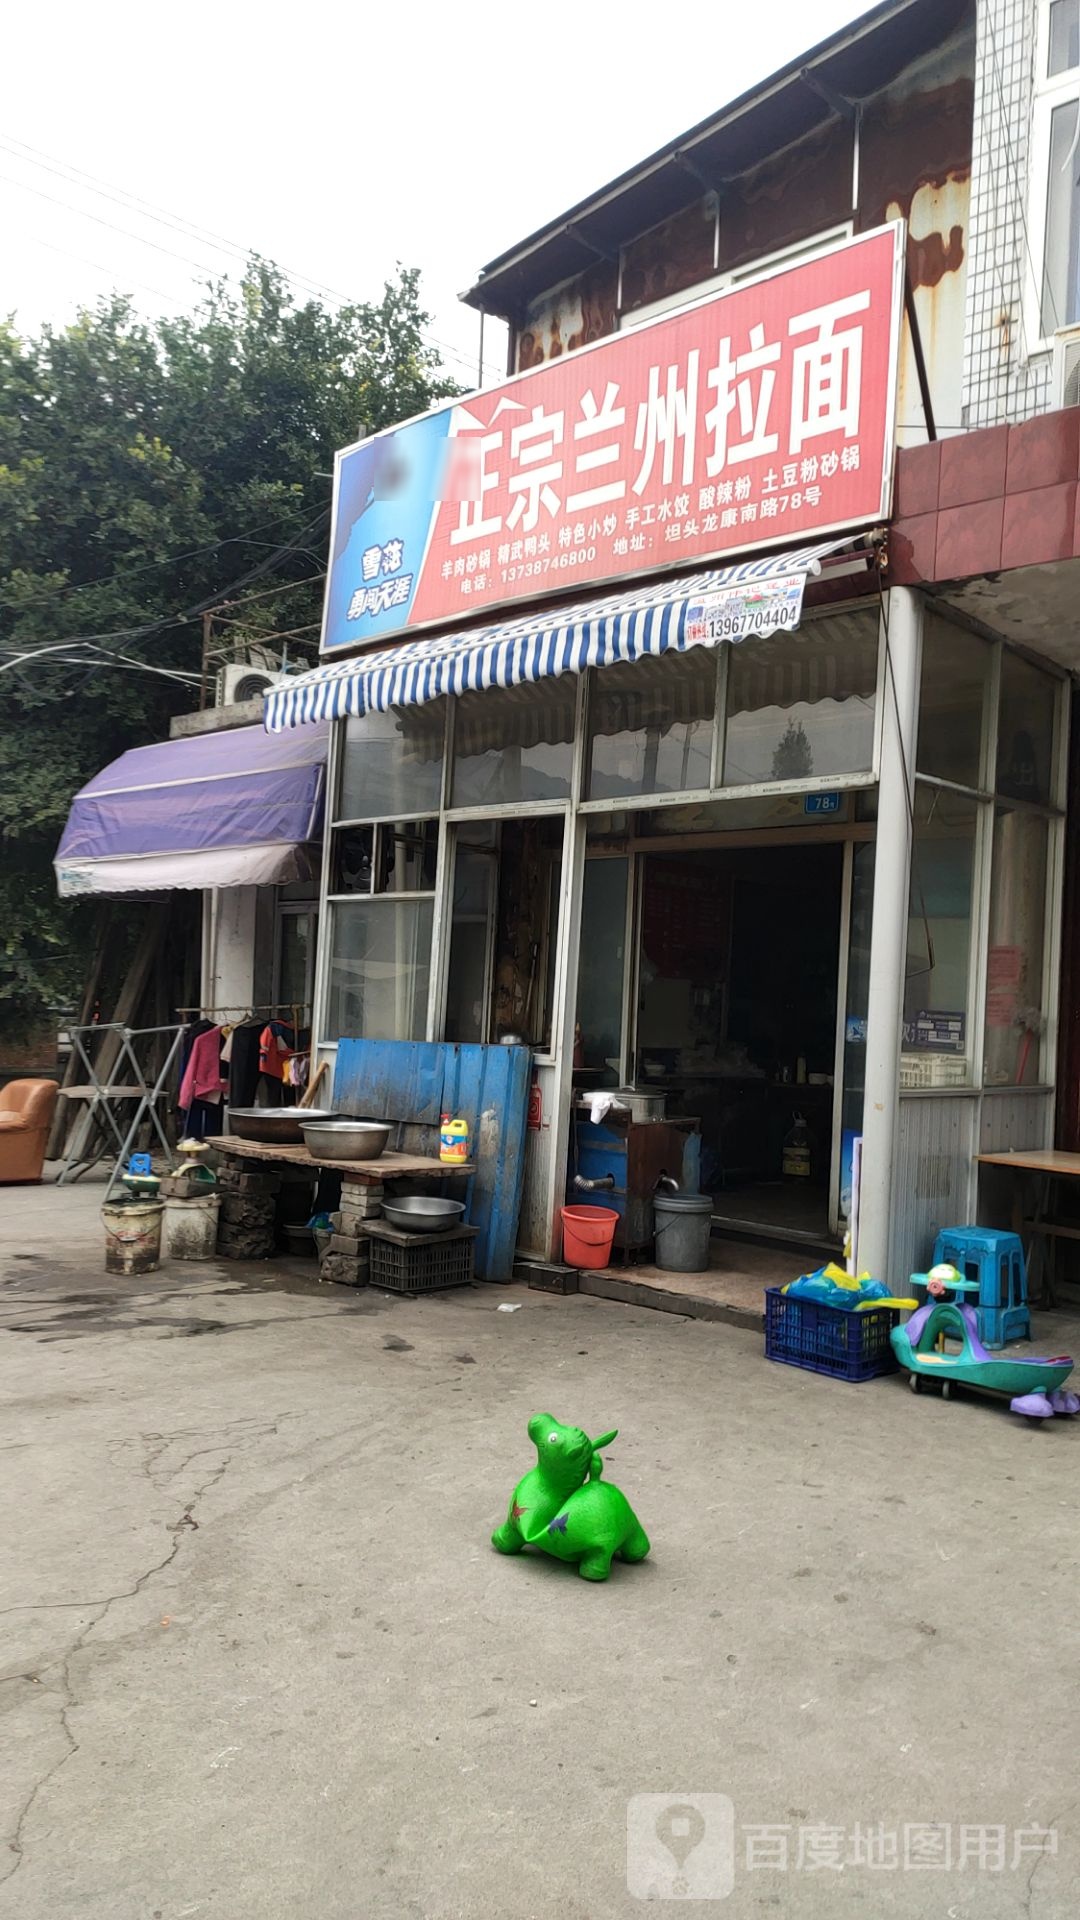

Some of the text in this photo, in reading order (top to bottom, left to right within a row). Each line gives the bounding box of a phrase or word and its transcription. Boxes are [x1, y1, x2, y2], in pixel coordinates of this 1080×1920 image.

[449, 289, 871, 545] 正宗兰州拉面
[441, 445, 860, 581] 羊肉砂锅 精武鸭头 特色小炒 手工水饺 酸辣粉 土豆粉砂锅
[501, 546, 596, 583] 13738746800
[665, 486, 822, 543] 坦头龙康南路78号
[709, 605, 797, 638] 13967704404
